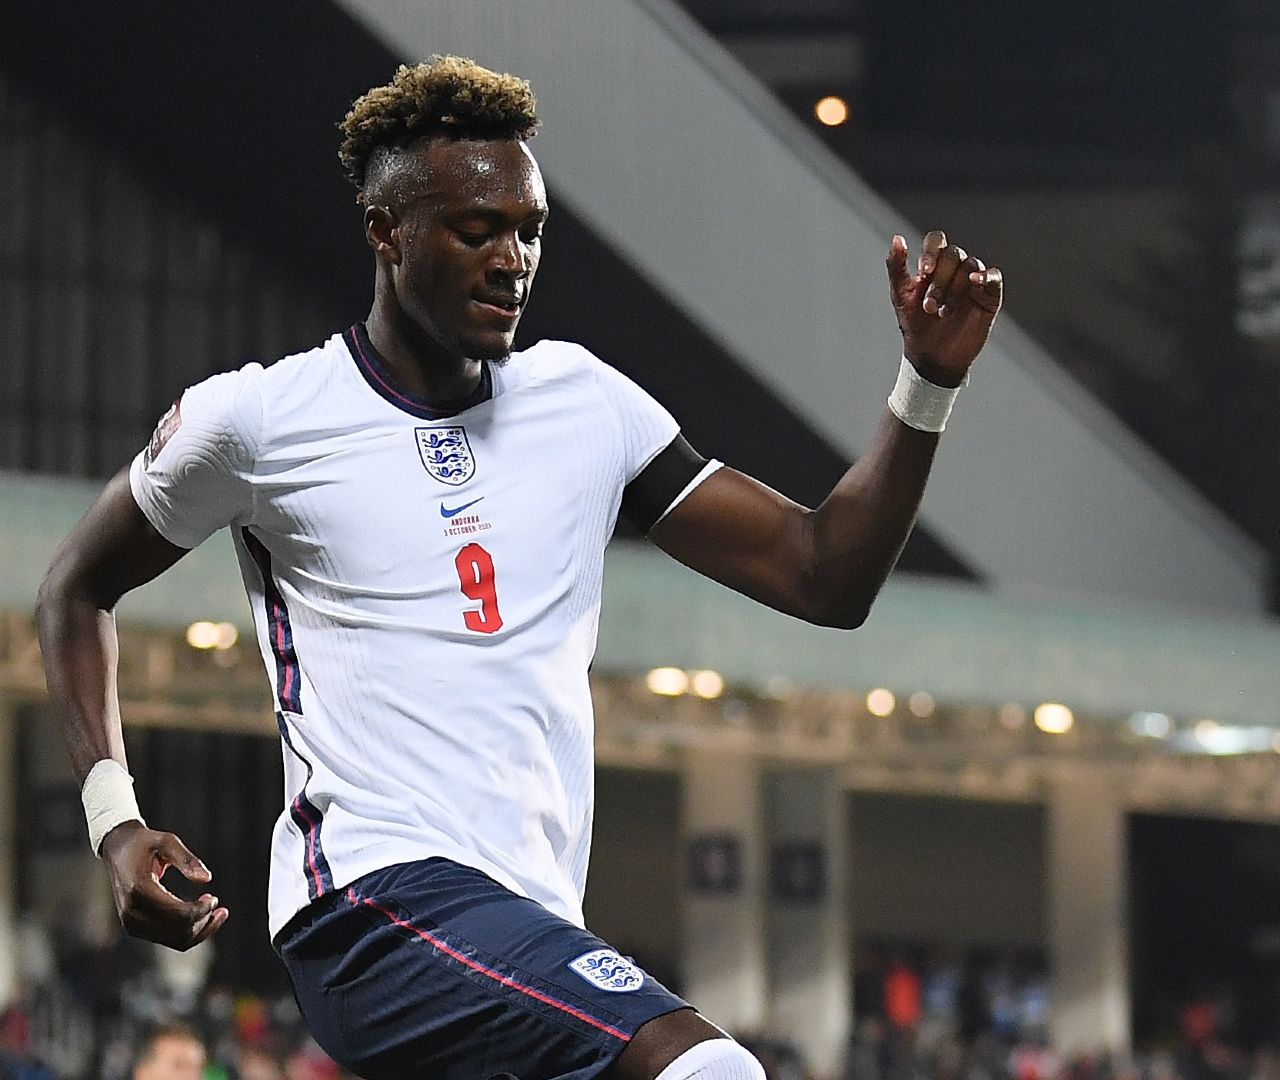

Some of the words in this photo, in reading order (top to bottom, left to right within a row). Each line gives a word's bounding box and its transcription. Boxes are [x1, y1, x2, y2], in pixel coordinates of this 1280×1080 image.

[451, 515, 480, 526] ANDORRA
[449, 526, 477, 536] OCTOBER
[454, 542, 504, 634] 9
